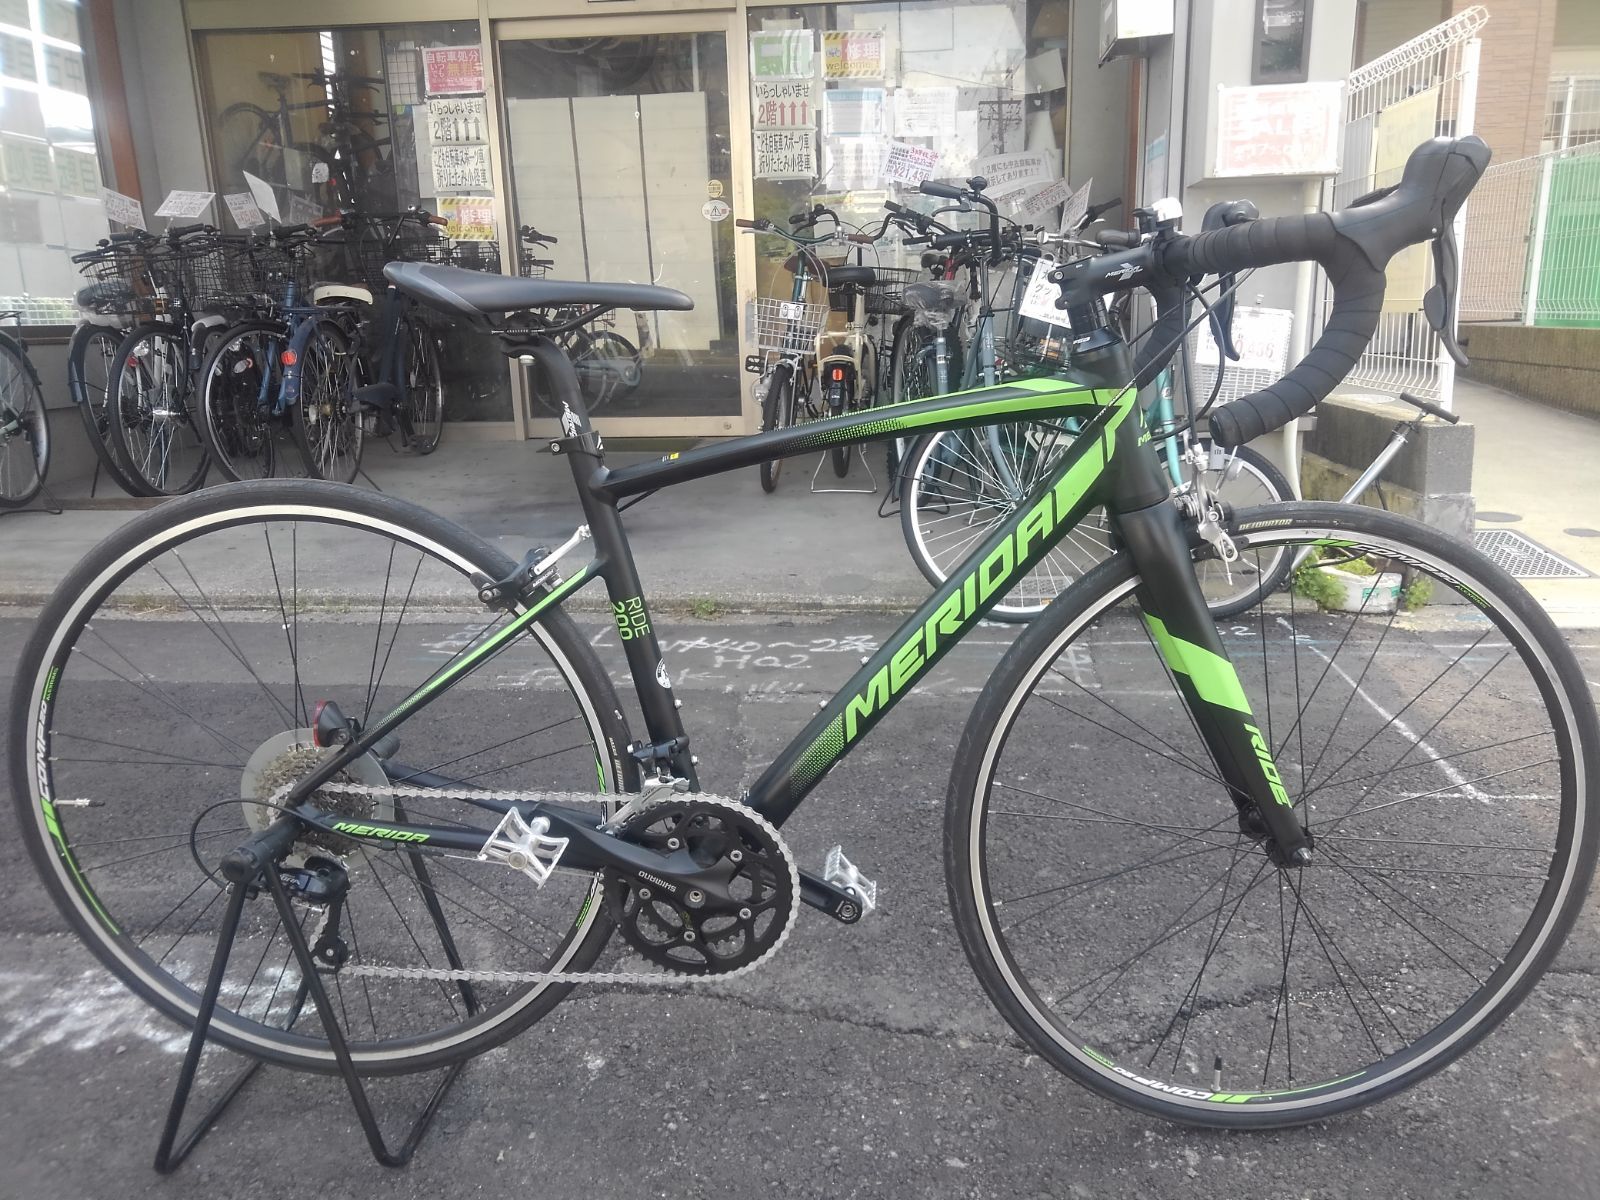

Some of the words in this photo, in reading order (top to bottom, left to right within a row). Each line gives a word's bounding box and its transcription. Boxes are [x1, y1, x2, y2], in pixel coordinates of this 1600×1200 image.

[426, 50, 479, 64] 自転車処分
[755, 83, 810, 98] いらっしゃいませ
[429, 100, 481, 115] いらっしゃいませ
[758, 100, 777, 126] 2階
[433, 117, 452, 142] 2階
[1239, 518, 1293, 531] DETONATOR
[612, 601, 633, 640] 200
[625, 596, 650, 638] RIDE
[845, 491, 1054, 743] MERIDA
[1243, 722, 1293, 809] RIDE
[332, 822, 430, 842] MERIDA
[638, 870, 677, 892] SHIMANO
